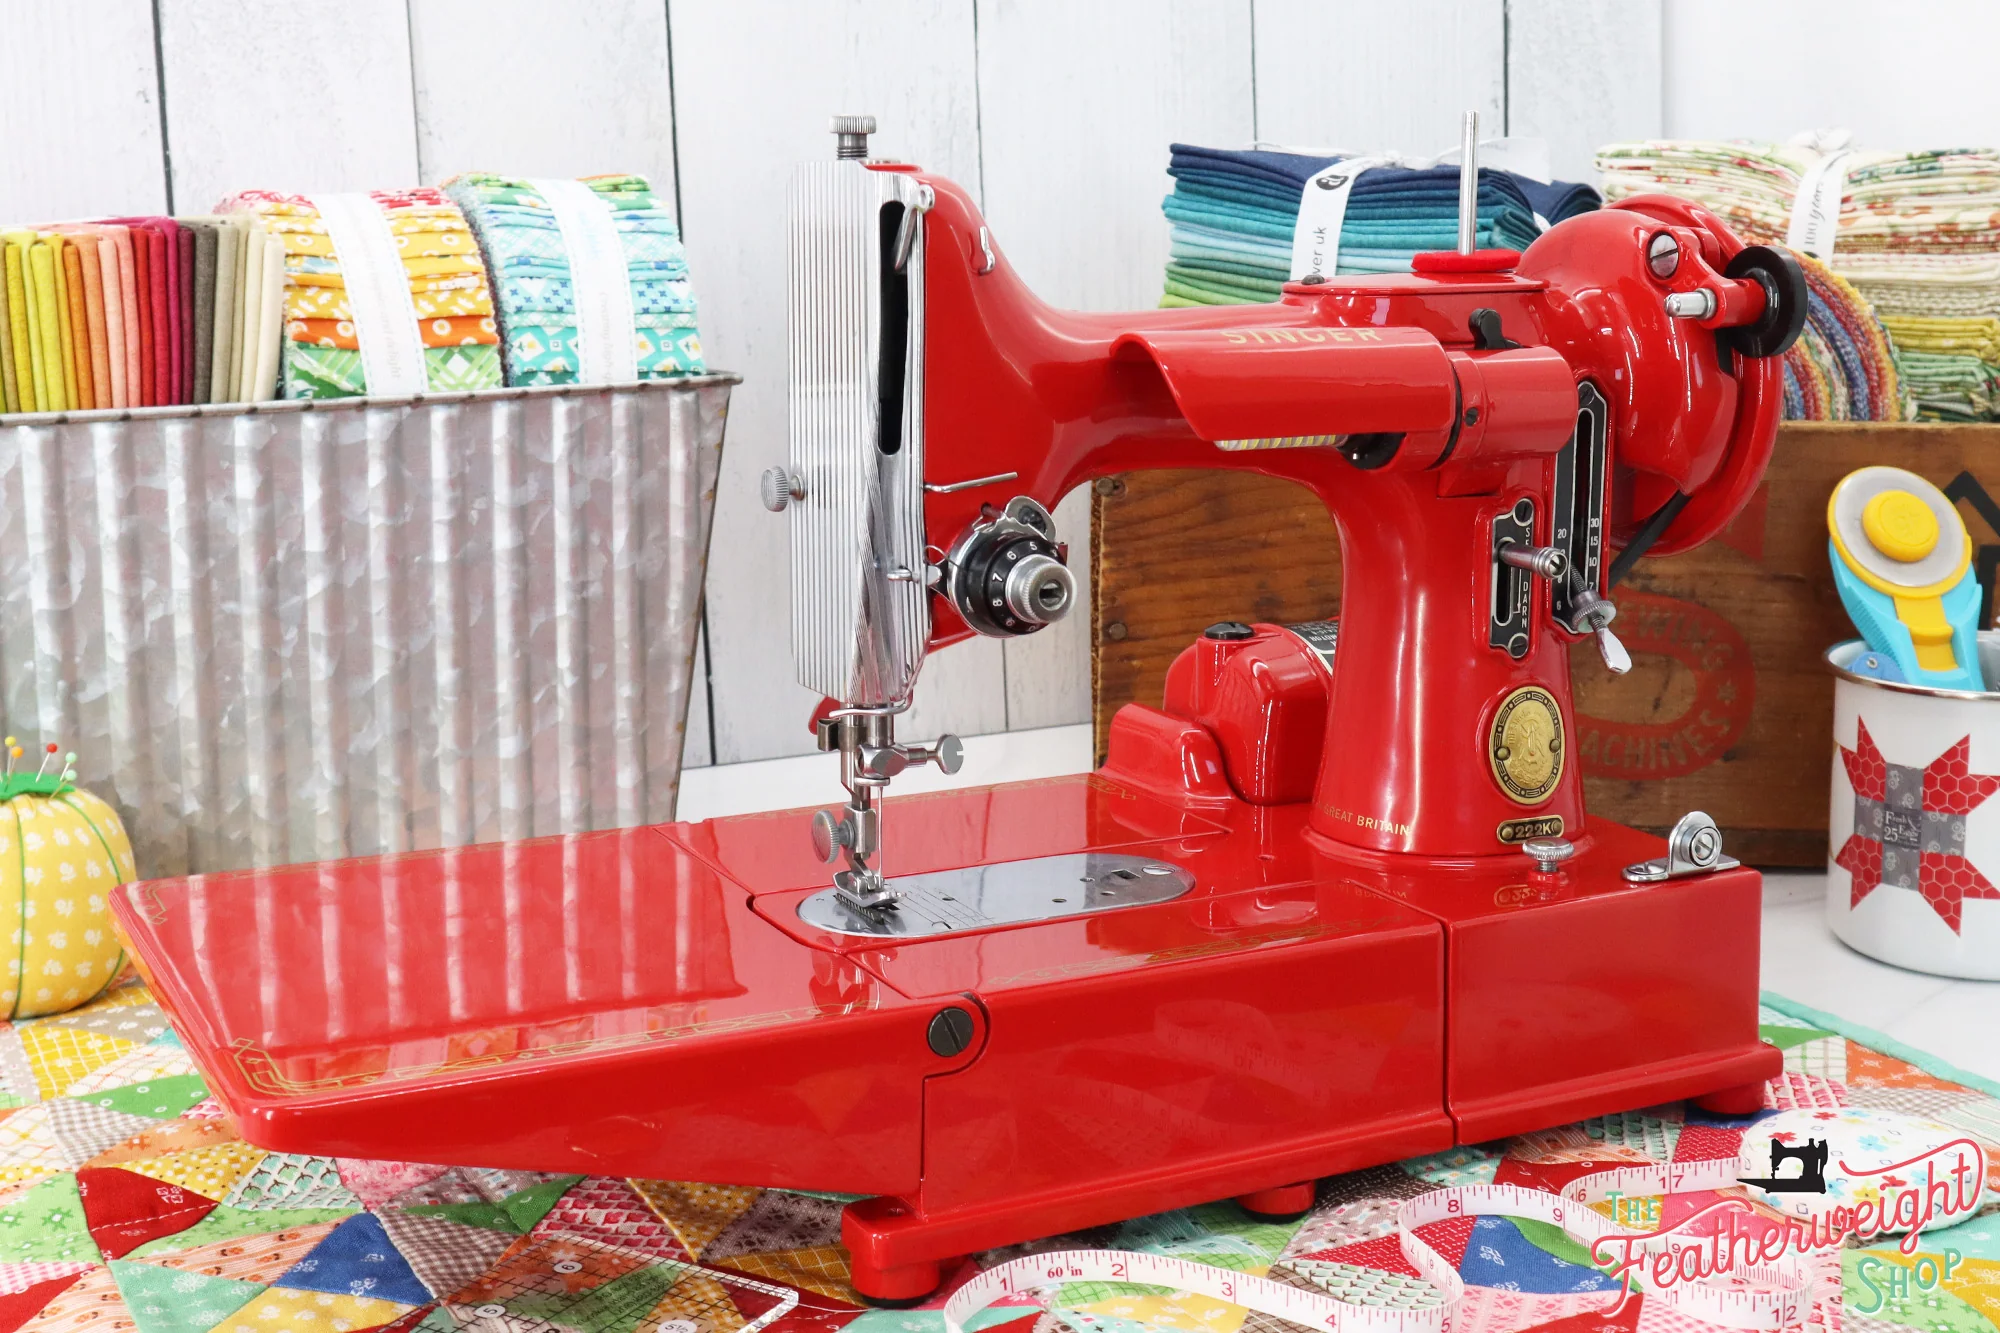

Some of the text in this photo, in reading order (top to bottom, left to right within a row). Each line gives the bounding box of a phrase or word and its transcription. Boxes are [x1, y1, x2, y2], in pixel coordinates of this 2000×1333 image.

[1312, 227, 1327, 245] uk
[1220, 328, 1382, 344] SINGER
[1590, 517, 1600, 528] 30
[1557, 528, 1567, 539] 20
[1590, 535, 1599, 546] 15
[1029, 541, 1038, 551] 5
[1006, 550, 1017, 560] 6
[1588, 556, 1597, 567] 10
[992, 572, 1003, 582] 7
[992, 598, 1003, 607] 8
[1521, 581, 1529, 628] DARN
[1609, 599, 1734, 672] EWING
[1323, 803, 1354, 823] GREAT
[1356, 815, 1410, 836] BRITAIN
[1515, 822, 1552, 838] 222K
[1884, 826, 1898, 842] 25
[1658, 1174, 1685, 1189] 17
[1447, 1199, 1460, 1213] 8
[1552, 1208, 1563, 1222] 9
[1046, 1265, 1063, 1279] 60
[1069, 1264, 1083, 1277] in
[1111, 1263, 1125, 1277] 2
[999, 1278, 1008, 1291] 1
[1221, 1282, 1233, 1296] 3
[1324, 1314, 1337, 1328] 4
[1771, 1305, 1797, 1323] 12
[1441, 1316, 1451, 1333] 5
